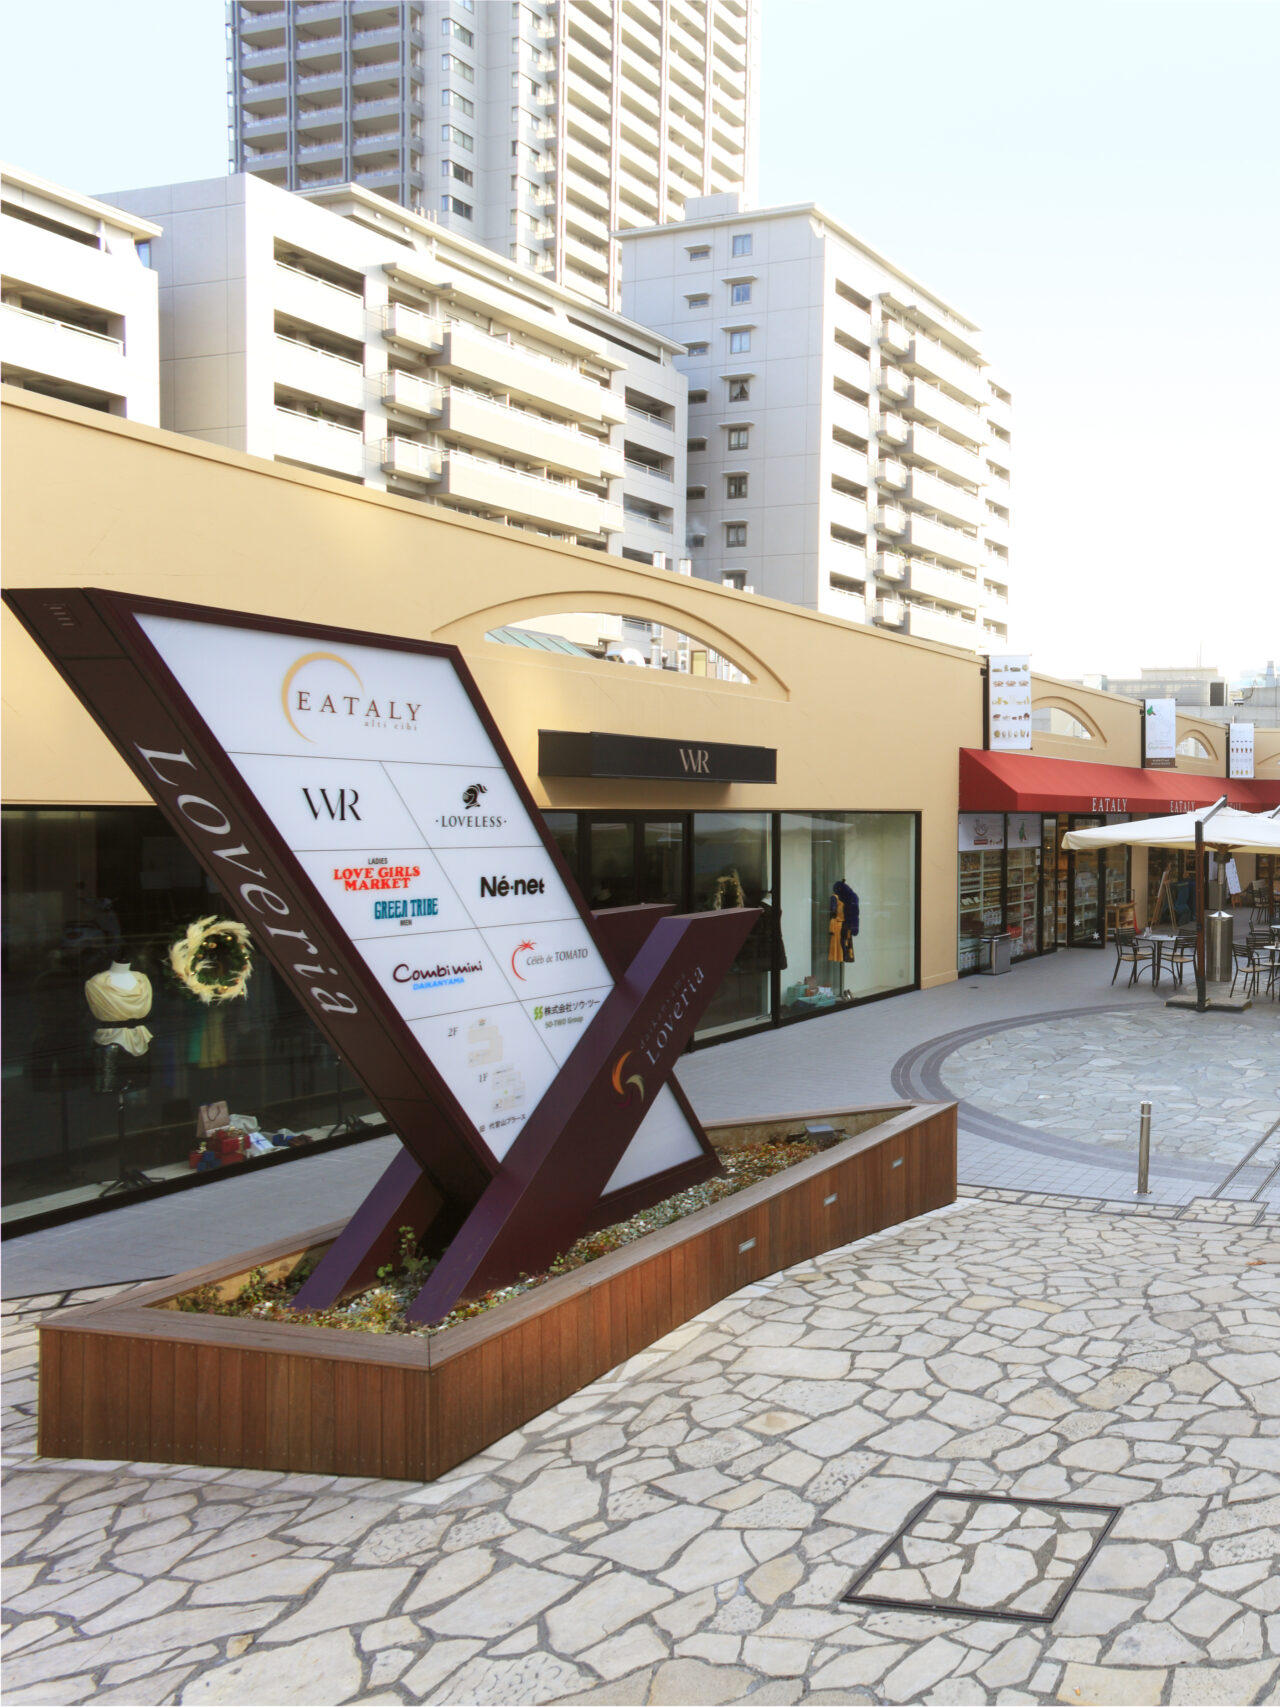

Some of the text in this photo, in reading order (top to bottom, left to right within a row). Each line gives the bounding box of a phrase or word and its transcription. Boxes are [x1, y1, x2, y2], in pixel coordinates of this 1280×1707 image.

[296, 690, 423, 722] EATALY
[679, 749, 711, 774] WR
[302, 787, 363, 821] WR
[1092, 797, 1128, 812] EATALY
[1170, 800, 1196, 813] EATALY
[441, 815, 503, 828] LOVELESS
[367, 857, 388, 865] LADIES
[133, 741, 359, 1015] Loveria
[333, 865, 421, 881] LOVE GIRLS
[344, 877, 412, 892] MARKET
[410, 898, 439, 917] TRIBE
[399, 919, 413, 927] MEN
[554, 948, 589, 962] TOMATO
[392, 960, 483, 983] Combi mini
[412, 976, 465, 991] DAIKANYAMA
[646, 966, 705, 1065] Loveria
[448, 1026, 459, 1037] 2F
[479, 1072, 489, 1083] 1F
